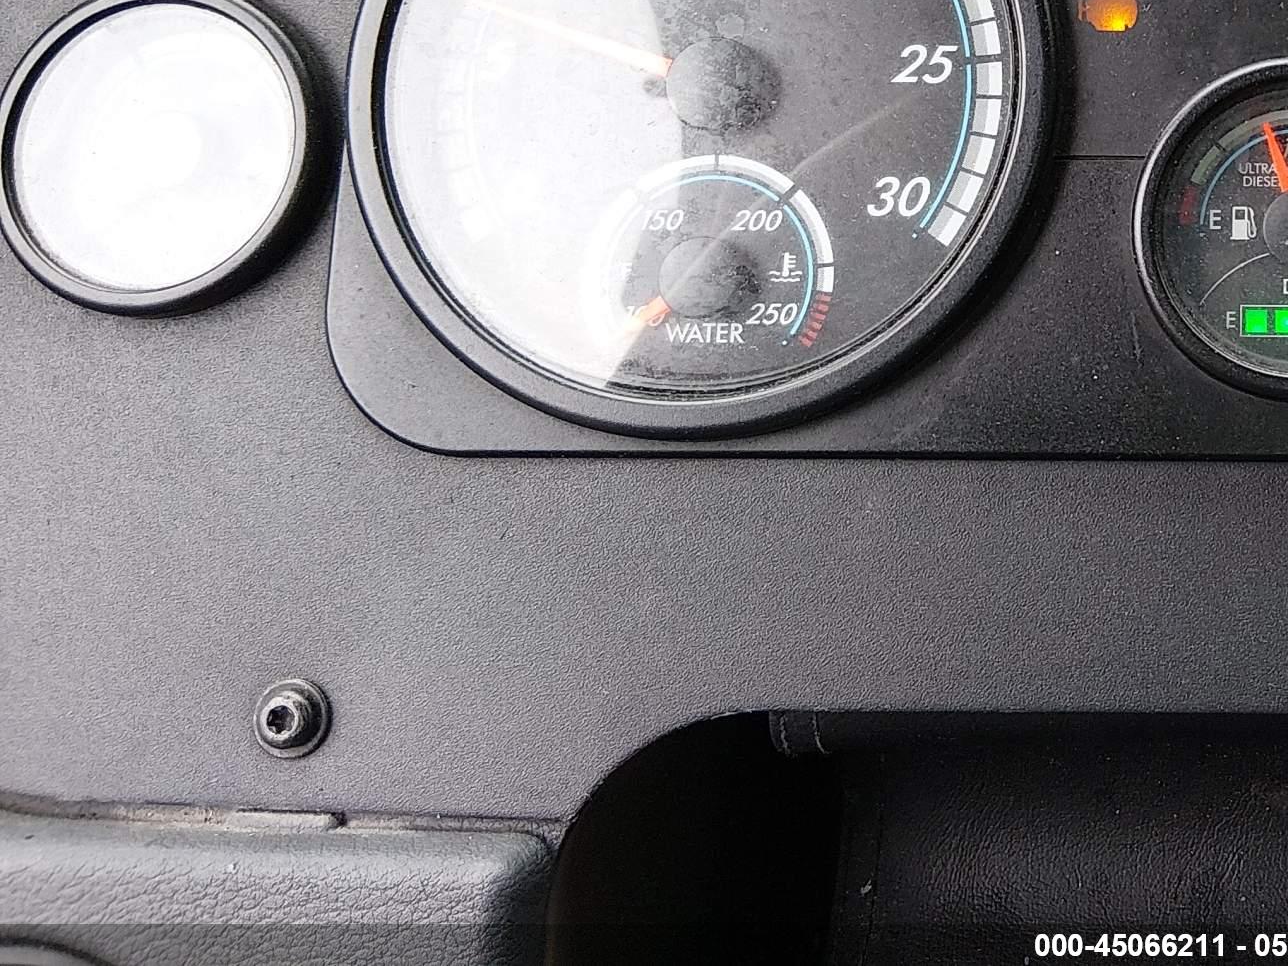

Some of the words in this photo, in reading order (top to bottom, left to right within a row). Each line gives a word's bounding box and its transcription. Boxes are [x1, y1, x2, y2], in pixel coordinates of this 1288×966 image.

[890, 43, 954, 84] 25
[1239, 162, 1277, 175] ULTRA
[1242, 175, 1280, 188] DIESE
[866, 176, 931, 217] 30
[641, 209, 684, 231] 150
[731, 209, 783, 232] 200
[1208, 209, 1222, 230] E
[745, 302, 798, 325] 250
[1225, 311, 1237, 329] E
[665, 322, 745, 344] WATER
